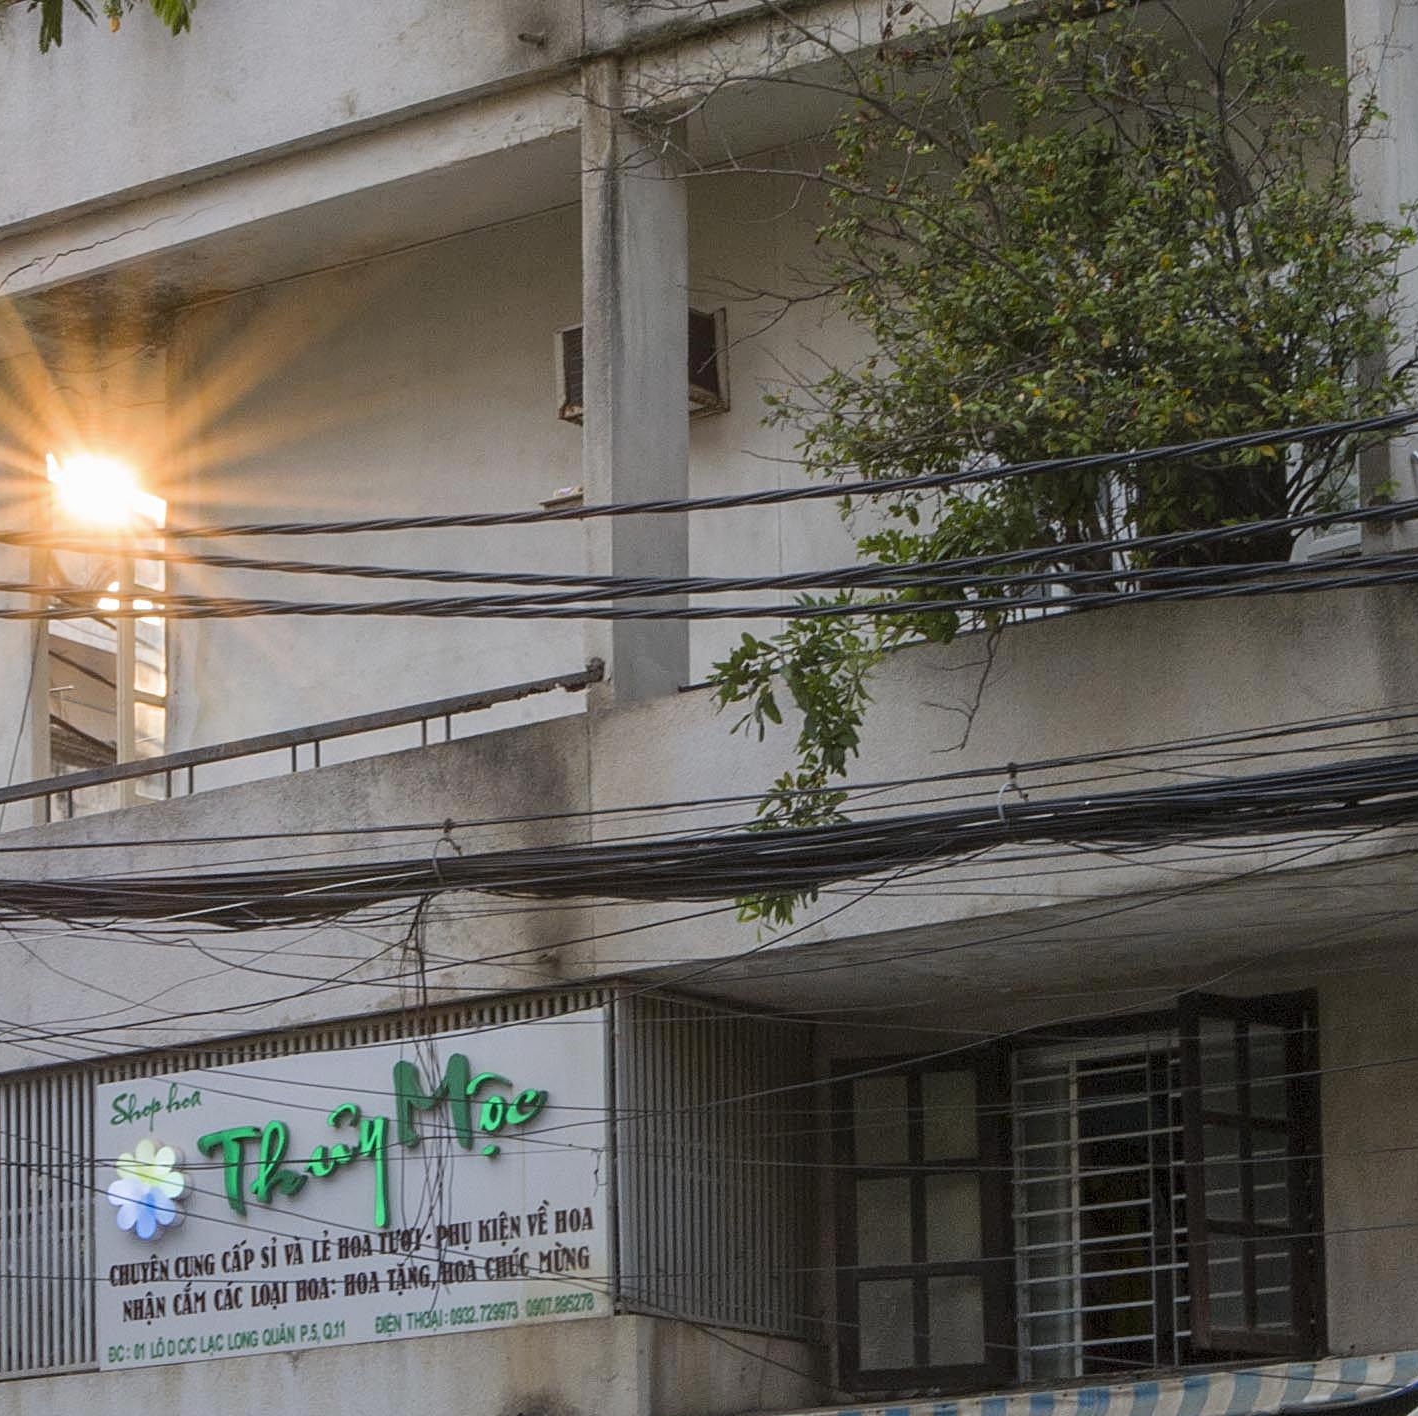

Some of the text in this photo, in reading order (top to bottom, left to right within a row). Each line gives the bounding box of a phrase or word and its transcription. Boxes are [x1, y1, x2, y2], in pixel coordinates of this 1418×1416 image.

[110, 1083, 202, 1132] Shop hoa
[393, 1053, 549, 1160] Mộc
[109, 1254, 169, 1287] CHUYÊN
[175, 1253, 215, 1278] CUNG
[222, 1240, 255, 1272] CẤP
[261, 1237, 277, 1269] SỈ
[285, 1236, 303, 1265] VÀ
[312, 1230, 330, 1262] LẺ
[338, 1234, 372, 1259] HOA
[436, 1223, 472, 1250] PHỤ
[479, 1211, 521, 1246] KIỆN
[528, 1200, 549, 1236] VỀ
[555, 1207, 593, 1234] HOA
[123, 1292, 165, 1325] NHẬN
[173, 1282, 206, 1315] CẮM
[214, 1281, 243, 1311] CÁC
[251, 1281, 288, 1310] LOẠI
[296, 1278, 336, 1302] HOA:
[344, 1271, 380, 1297] HOA
[440, 1259, 477, 1285] HOA
[485, 1249, 530, 1280] CHÚC
[539, 1242, 590, 1273] MỪNG
[227, 1331, 258, 1350] LONG
